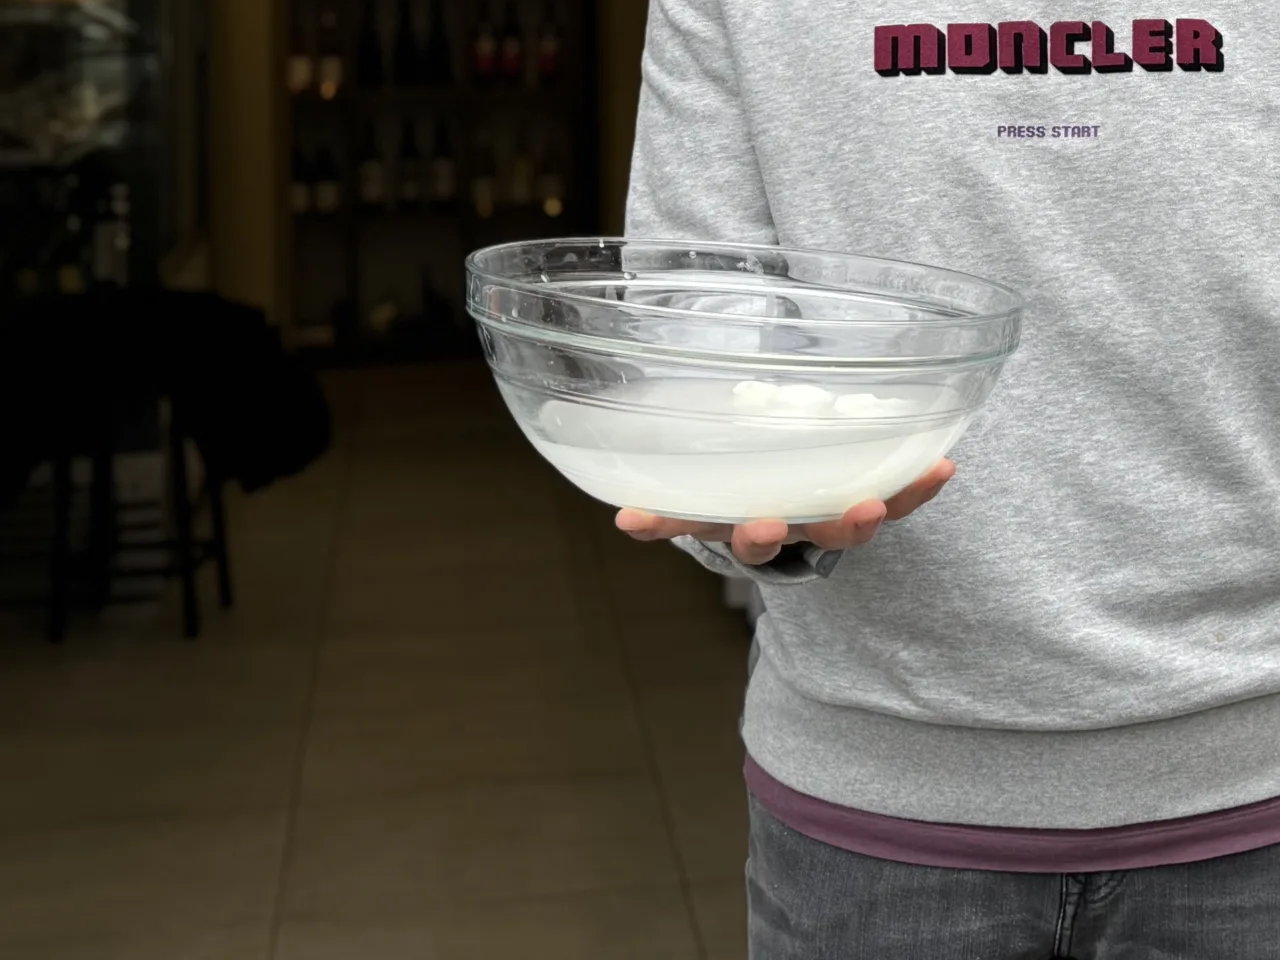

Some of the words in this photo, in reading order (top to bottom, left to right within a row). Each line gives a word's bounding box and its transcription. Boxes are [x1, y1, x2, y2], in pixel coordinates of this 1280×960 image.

[874, 19, 1224, 77] MONCLER
[997, 125, 1046, 138] PRESS
[1051, 125, 1101, 138] START
